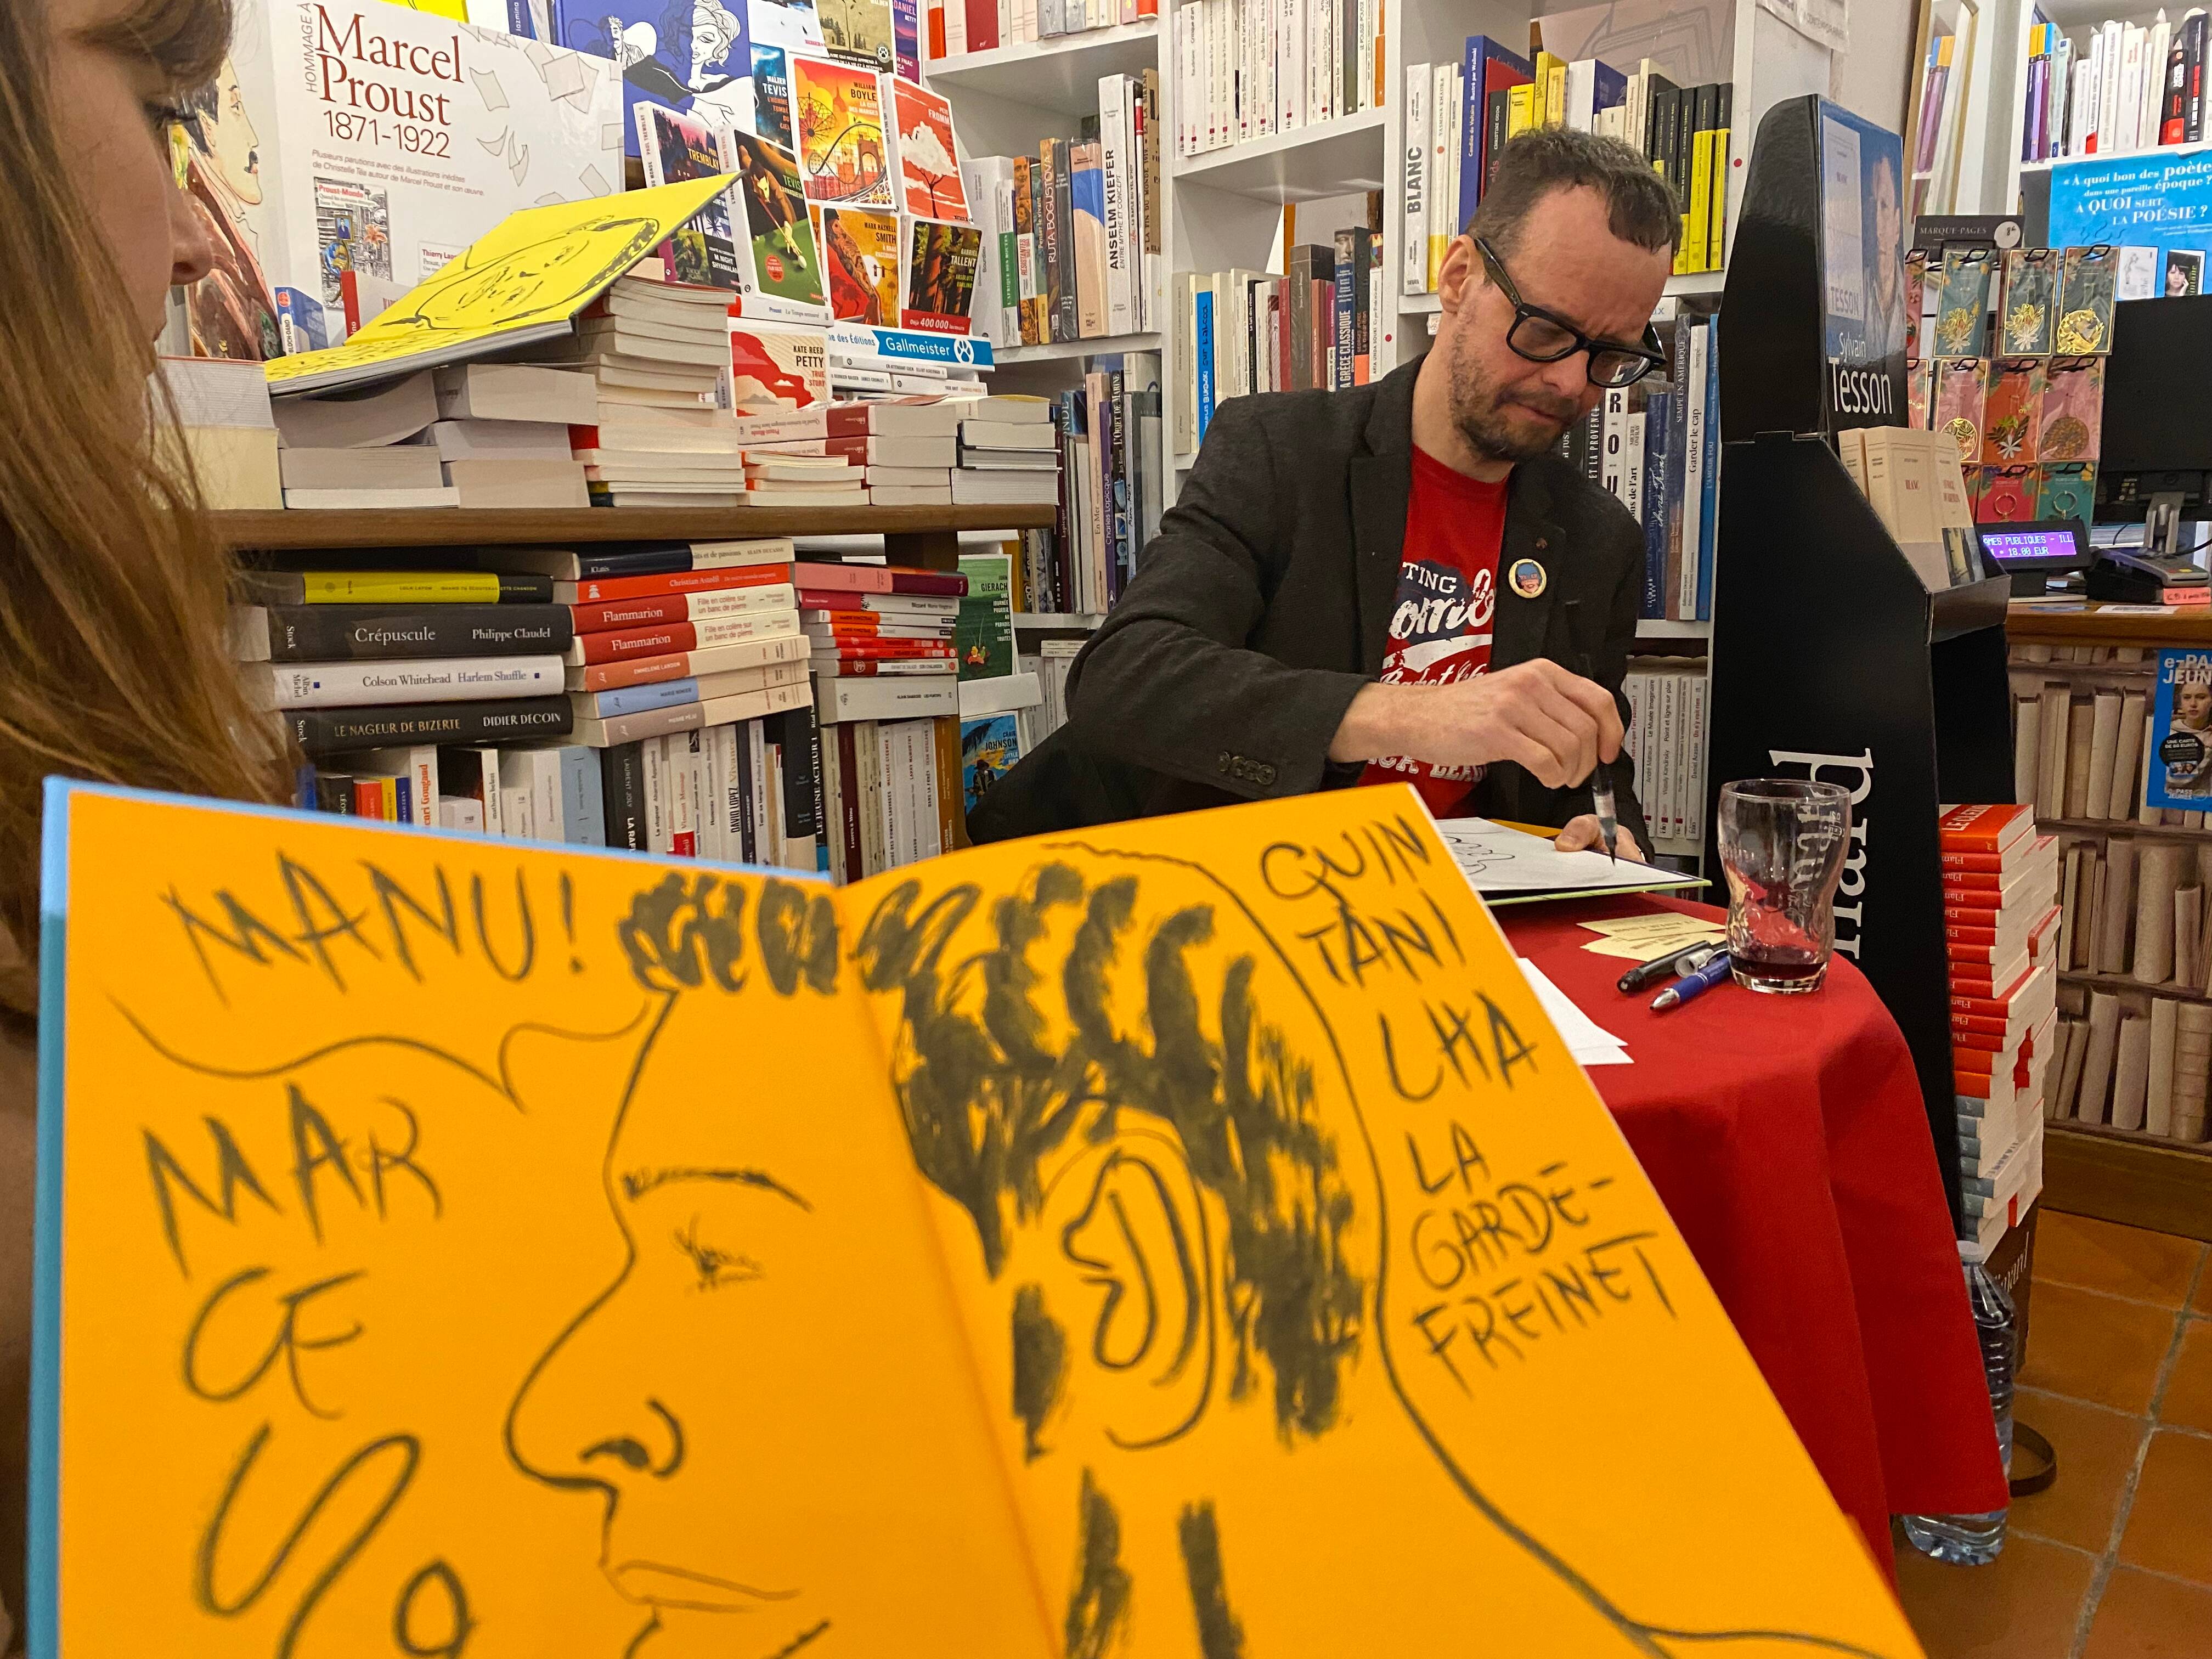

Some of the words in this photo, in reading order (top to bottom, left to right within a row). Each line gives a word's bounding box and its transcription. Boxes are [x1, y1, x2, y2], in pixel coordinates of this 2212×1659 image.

[297, 3, 310, 13] À
[894, 1, 917, 16] DANIEL
[301, 14, 317, 93] HOMMAGE
[313, 3, 465, 83] Marcel
[316, 53, 452, 126] Proust
[763, 83, 788, 97] TEVIS
[850, 89, 877, 101] BOYLE
[854, 82, 876, 91] WILLIAM
[928, 109, 950, 124] FROMM
[324, 110, 450, 159] 1871-1922
[688, 148, 720, 170] TREMBLAY
[783, 175, 802, 191] TEVIS
[1105, 149, 1115, 206] KIEFER
[1407, 146, 1422, 214] BLANC
[2072, 173, 2080, 186] À
[2084, 173, 2110, 188] quoi
[2113, 171, 2136, 183] bon
[2140, 169, 2159, 179] des
[2084, 189, 2103, 197] dans
[2121, 184, 2152, 195] pareille
[2154, 177, 2204, 192] époque
[1042, 156, 1055, 229] BOGUSTOVA
[2076, 201, 2084, 213] À
[2088, 196, 2132, 215] QUOI
[2135, 197, 2164, 208] SERT
[2113, 216, 2128, 225] LA
[2132, 205, 2197, 223] POÉSIE
[876, 232, 896, 243] SMITH
[1107, 209, 1118, 269] ANSELM
[1920, 225, 1987, 235] MARQUE-PAGES
[951, 255, 977, 267] TALLENT
[1830, 285, 1860, 317] TESSON
[1339, 309, 1351, 355] CLASSIQUE
[793, 345, 808, 354] KATE
[809, 346, 823, 354] REED
[837, 334, 848, 344] des
[850, 331, 876, 346] Éditions
[885, 337, 950, 357] Gallmeister
[1839, 331, 1866, 364] Sylvain
[796, 355, 823, 368] PETTY
[1337, 356, 1351, 381] GRÈCE
[1677, 340, 1686, 383] AMÉRIQUE
[1112, 373, 1120, 405] MARINE
[1678, 385, 1684, 396] EN
[1829, 357, 1893, 415] Tesson
[1113, 405, 1121, 416] DE
[1691, 408, 1701, 427] cap
[1690, 428, 1699, 438] le
[1589, 455, 1598, 465] LA
[1689, 440, 1697, 473] Garder
[1589, 469, 1598, 478] ET
[1629, 466, 1638, 486] l'art
[1649, 453, 1666, 490] Frank
[1630, 486, 1637, 499] de
[1653, 492, 1664, 527] Anne
[1096, 524, 1101, 535] En
[2005, 535, 2046, 545] PUBLIQUES
[2008, 546, 2032, 557] 18.00
[2035, 546, 2050, 555] EUR
[980, 582, 1008, 592] GIERACH
[1402, 562, 1457, 594] TING
[603, 607, 663, 623] Flammarion
[730, 603, 747, 612] pierre
[286, 625, 295, 649] Stock
[354, 627, 436, 646] Crépuscule
[472, 628, 513, 642] Philippe
[514, 627, 551, 640] Claudel
[611, 634, 671, 651] Flammarion
[294, 674, 302, 699] Michel
[363, 674, 397, 689] Colson
[399, 673, 452, 687] Whitehead
[458, 671, 493, 684] Harlem
[494, 669, 527, 682] Shuffle
[297, 719, 306, 743] Stock
[334, 725, 347, 737] LE
[349, 722, 398, 737] NAGEUR
[400, 720, 415, 733] DE
[419, 718, 461, 731] BIZERTE
[483, 714, 519, 728] DIDIER
[520, 712, 561, 726] DECOIN
[986, 737, 1017, 751] JOHNSON
[812, 746, 821, 785] ACTEUR
[729, 786, 739, 809] LOPEZ
[815, 786, 823, 820] JEUNE
[730, 810, 741, 833] DAVID
[816, 821, 823, 834] LE
[1259, 812, 1432, 915] QUIN
[157, 848, 586, 1011] MANU!
[1296, 888, 1468, 989] TANI
[1378, 990, 1538, 1104] LHA
[1406, 1120, 1491, 1195] LA
[140, 1081, 444, 1283] MAR
[1411, 1159, 1615, 1293] GARDE-
[1414, 1231, 1679, 1401] FREINET
